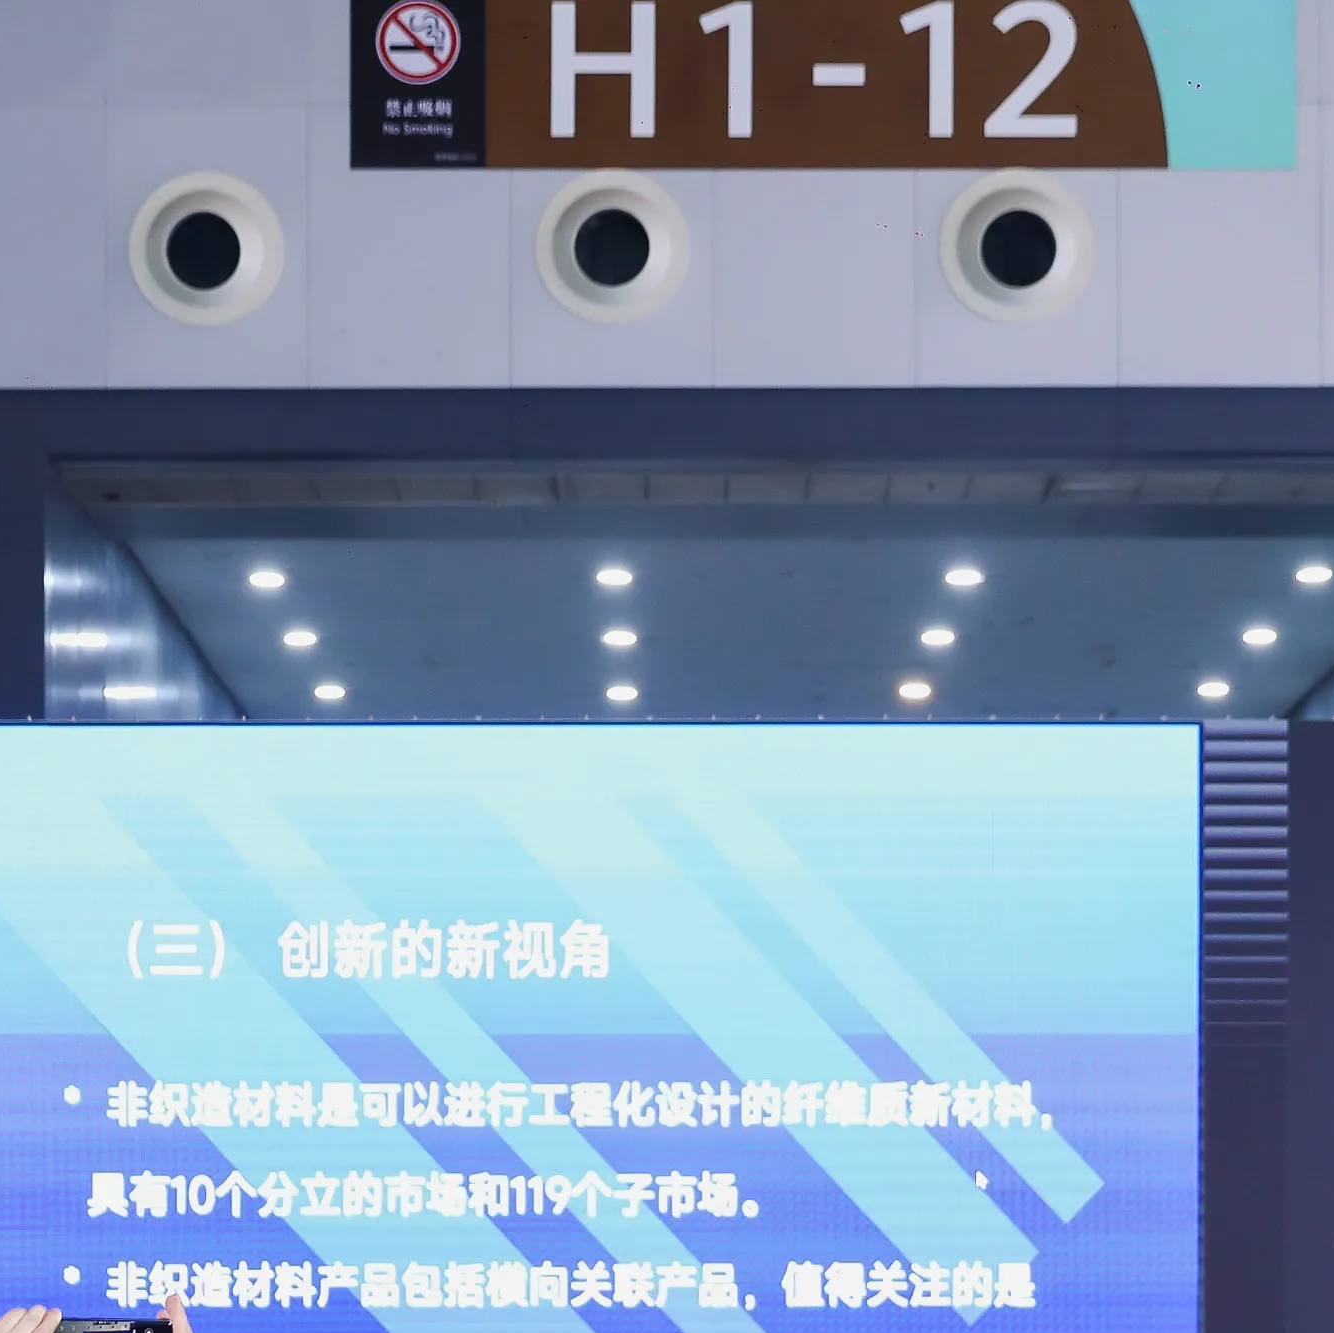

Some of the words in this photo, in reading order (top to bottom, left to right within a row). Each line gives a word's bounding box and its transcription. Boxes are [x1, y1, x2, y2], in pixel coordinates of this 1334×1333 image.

[277, 918, 610, 980] 创新的新视角
